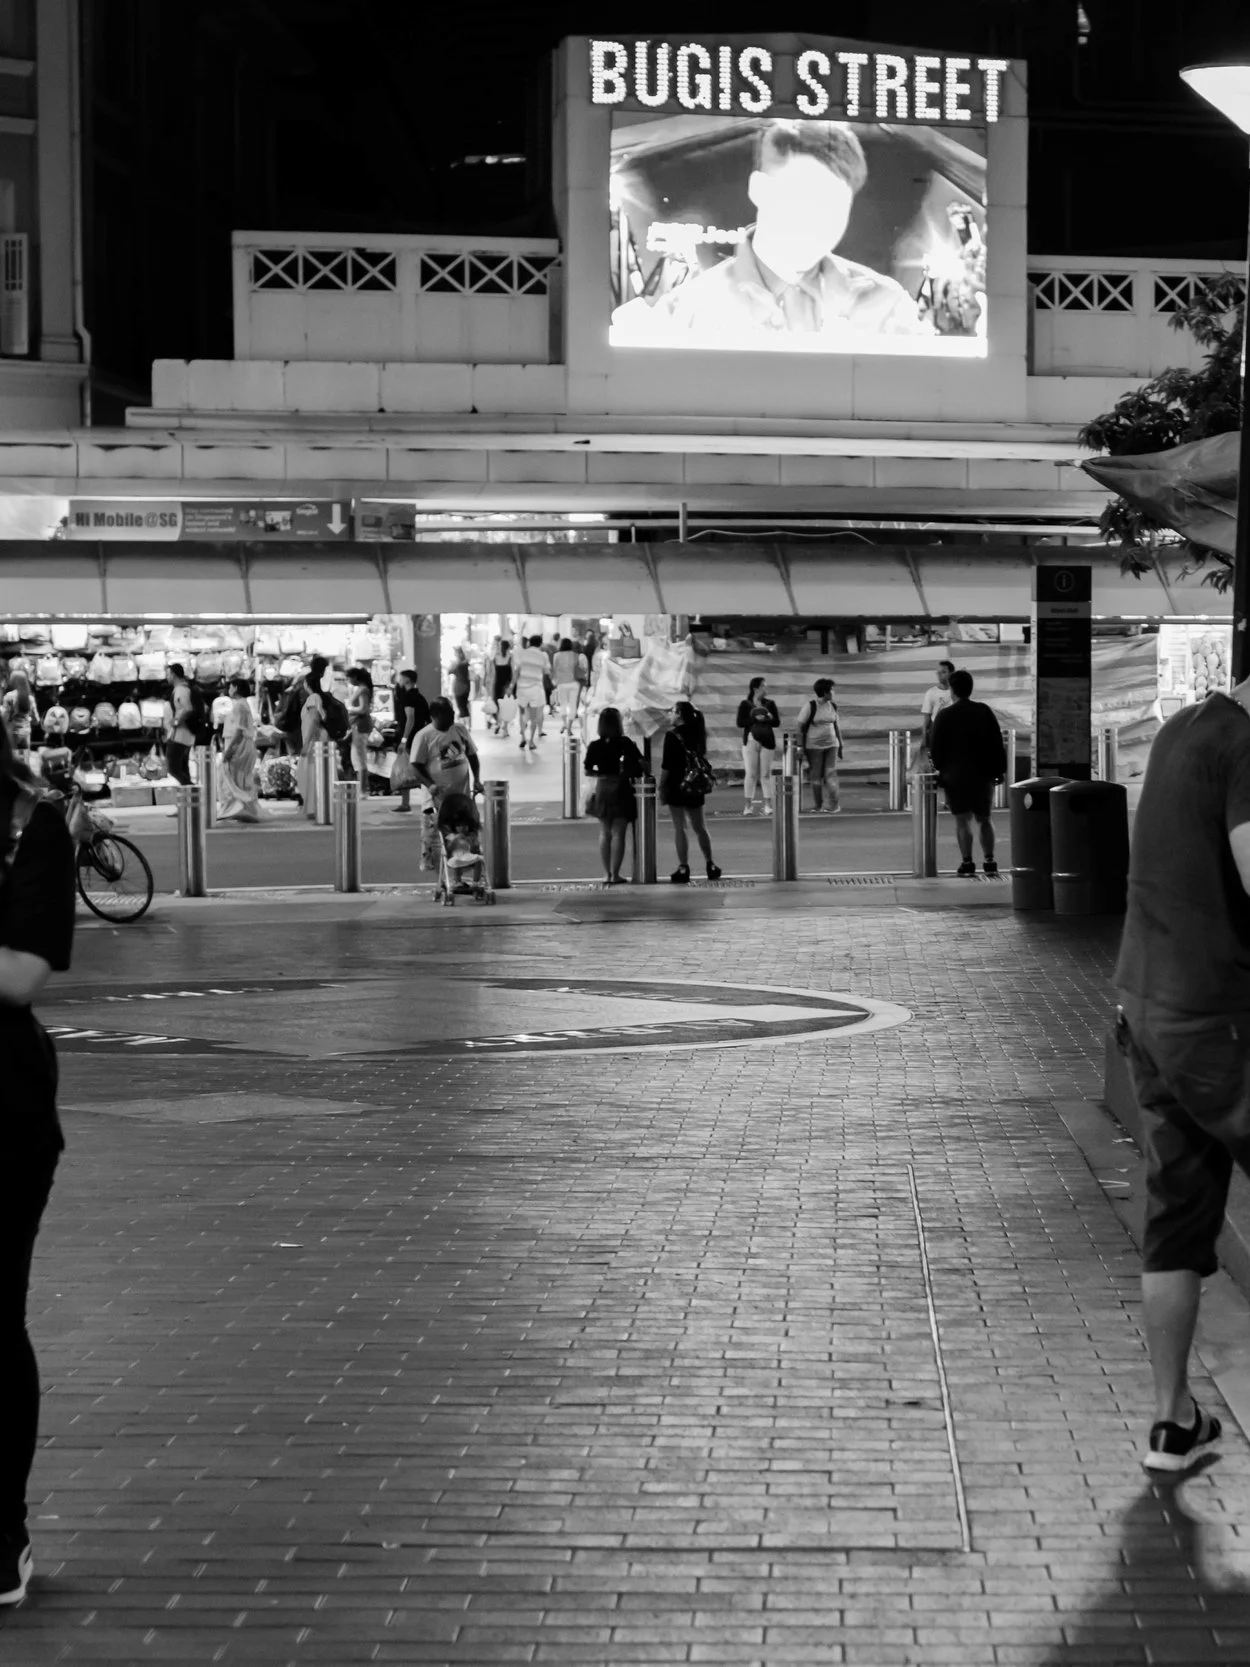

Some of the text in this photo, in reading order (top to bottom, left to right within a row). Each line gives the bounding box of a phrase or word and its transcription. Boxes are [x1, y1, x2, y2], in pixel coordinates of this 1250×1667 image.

[591, 40, 1008, 123] BUGIS STREET
[93, 512, 178, 527] Mobile@SG
